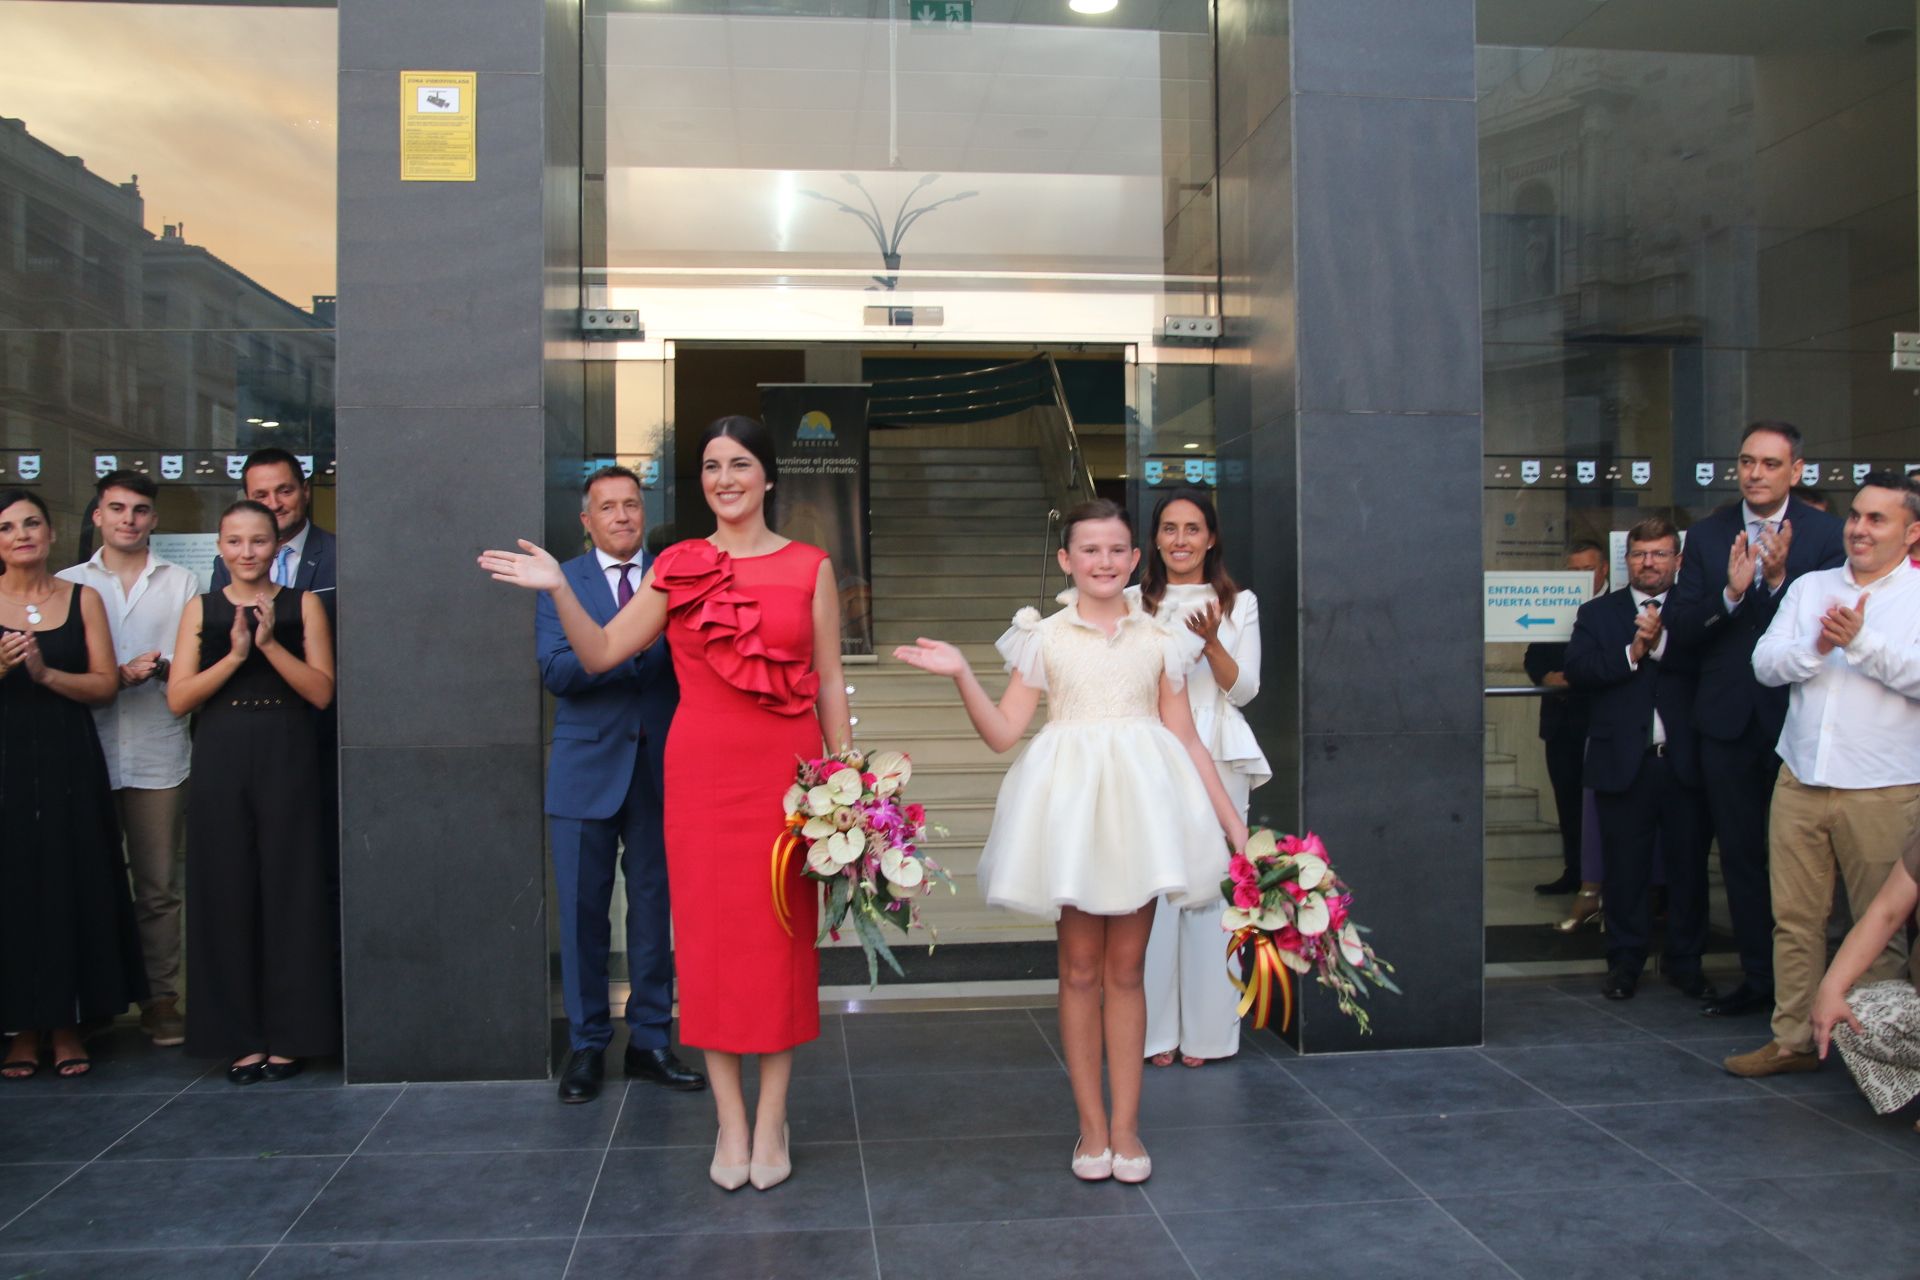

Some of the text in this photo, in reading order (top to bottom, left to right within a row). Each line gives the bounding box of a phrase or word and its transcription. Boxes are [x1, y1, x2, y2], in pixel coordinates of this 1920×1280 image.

[775, 457, 812, 465] luminar
[813, 457, 821, 465] el
[1488, 586, 1582, 594] ENTRADA POR LA
[1488, 598, 1532, 607] PUERTA
